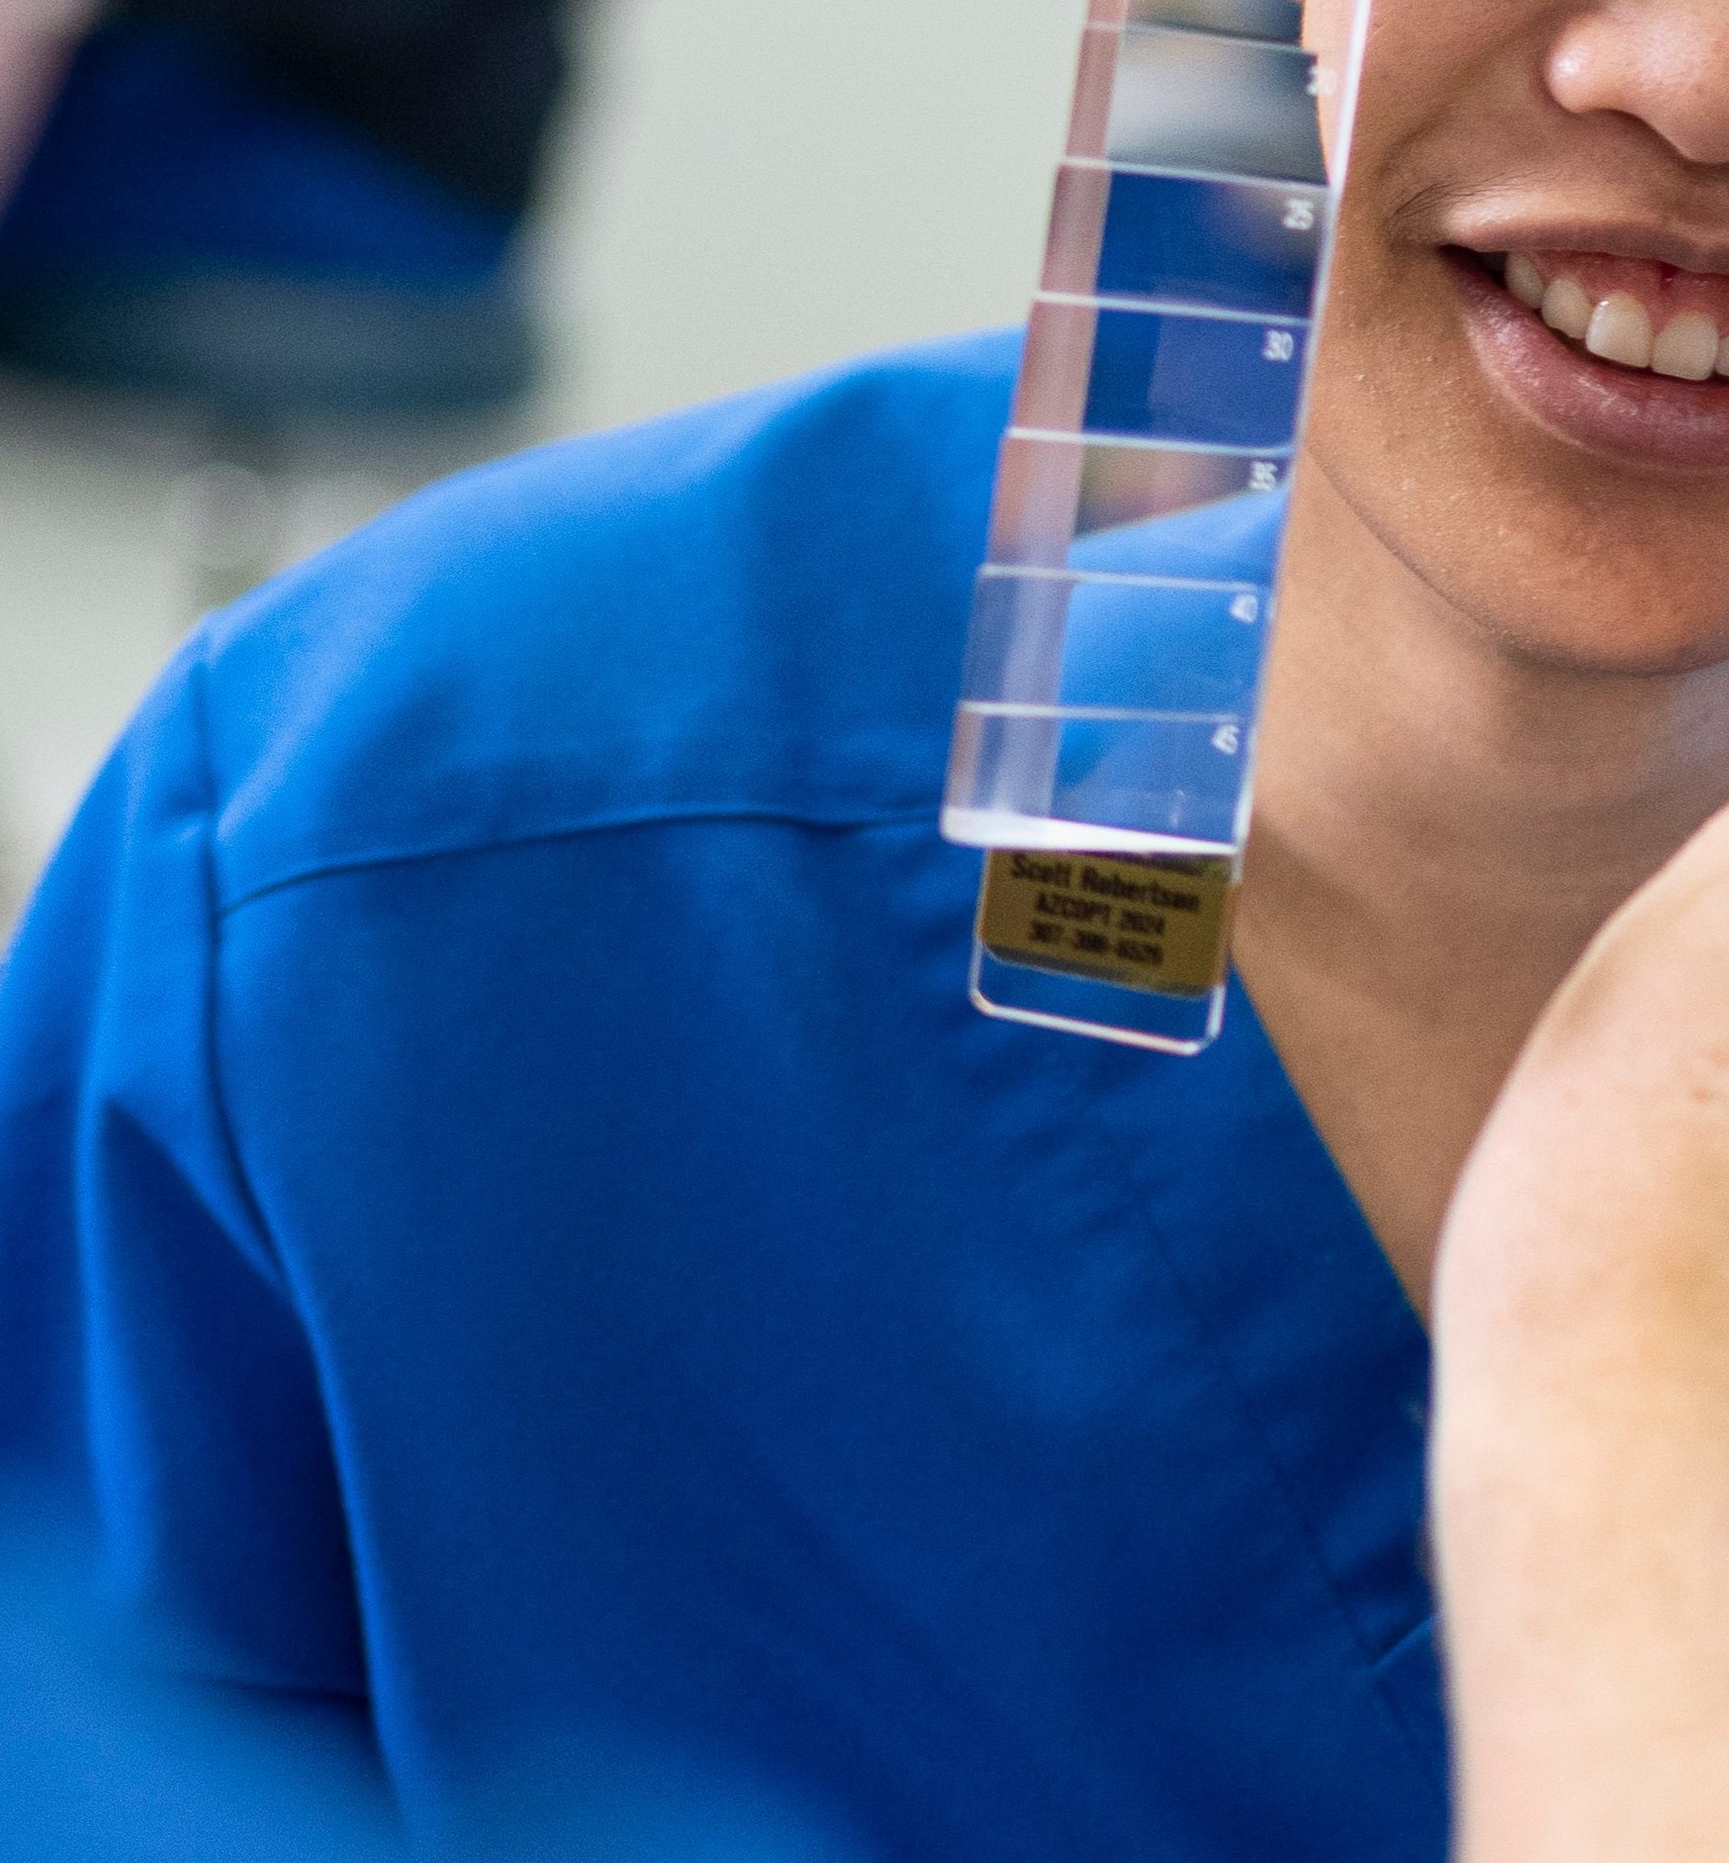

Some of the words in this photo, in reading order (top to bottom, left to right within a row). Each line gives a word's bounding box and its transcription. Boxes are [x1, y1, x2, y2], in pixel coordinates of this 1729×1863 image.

[1283, 198, 1314, 231] 25
[1262, 329, 1294, 362] 30
[1229, 594, 1259, 624] 40
[1211, 723, 1240, 755] 45
[1010, 852, 1073, 888] Scott
[1081, 865, 1201, 913] Robertson
[1118, 909, 1166, 936] 2024
